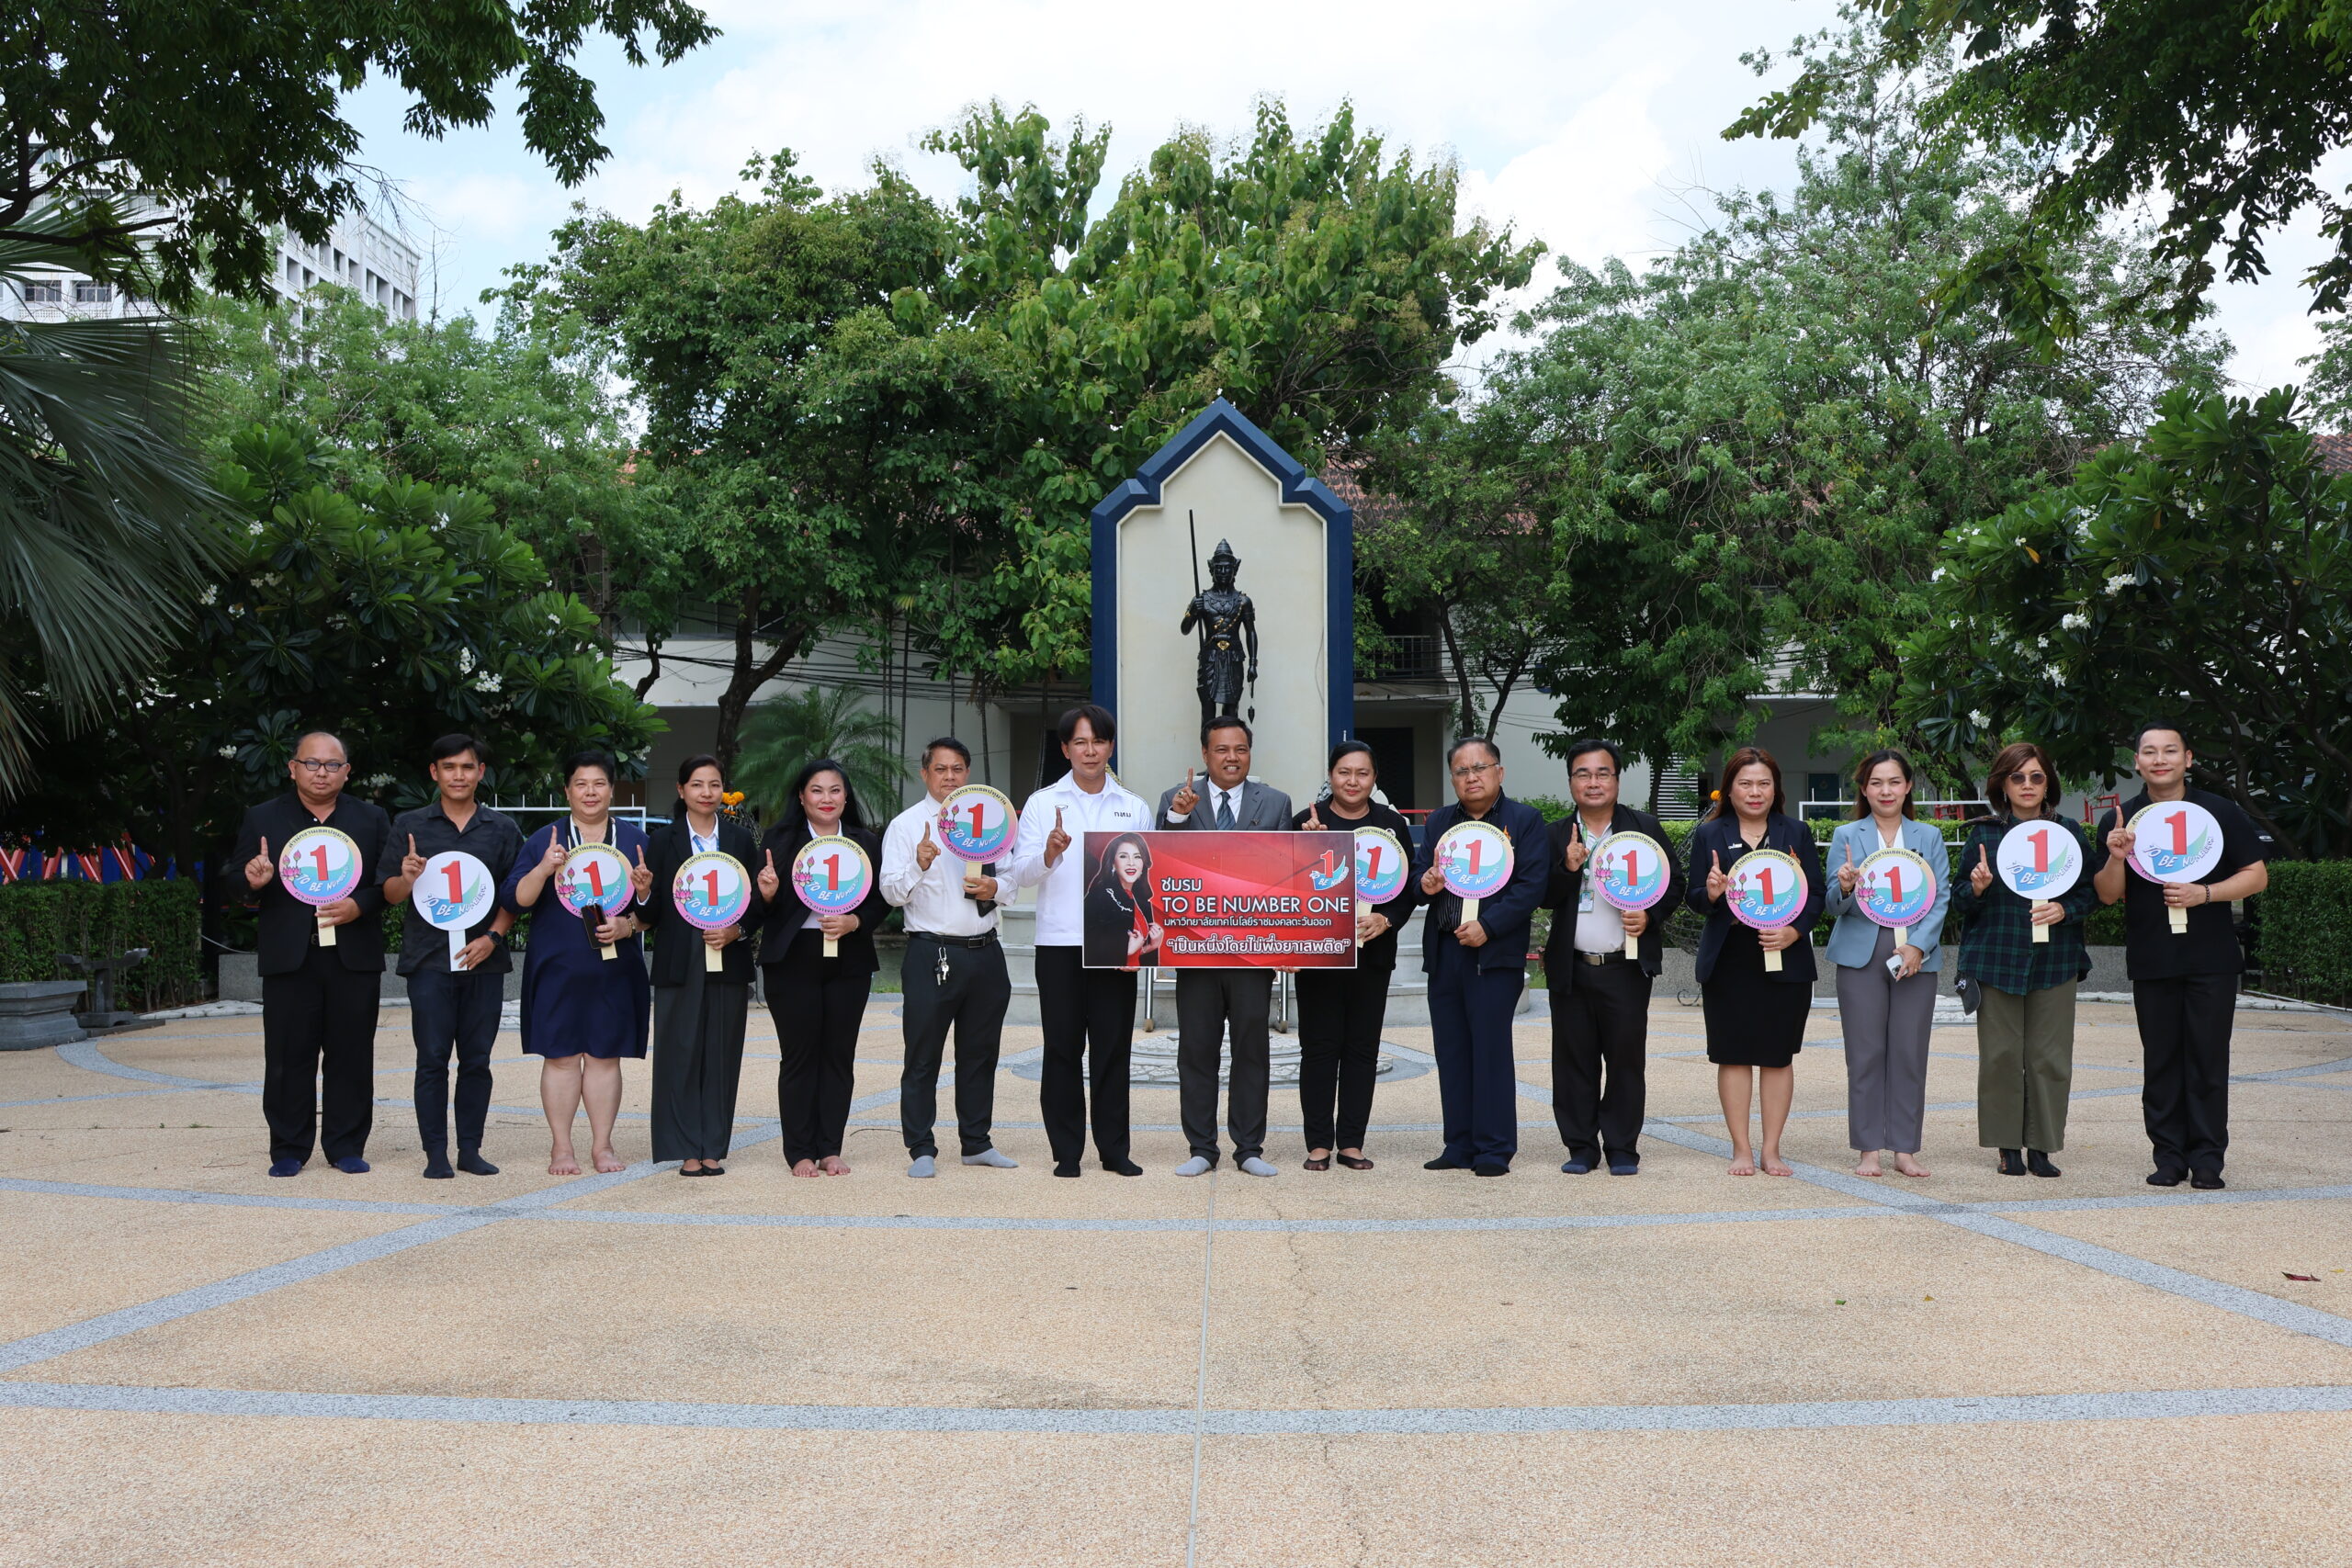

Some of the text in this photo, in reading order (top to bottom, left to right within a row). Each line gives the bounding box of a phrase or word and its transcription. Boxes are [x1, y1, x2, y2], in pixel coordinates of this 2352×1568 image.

[967, 803, 984, 838] 1
[2165, 811, 2188, 855] 1
[962, 838, 977, 847] BE
[1465, 840, 1482, 874] 1
[2027, 829, 2049, 873] 1
[310, 844, 329, 881] 1
[1367, 846, 1382, 881] 1
[1622, 850, 1637, 886] 1
[2157, 855, 2178, 867] BE
[583, 861, 604, 897] 1
[823, 854, 839, 890] 1
[1458, 874, 1473, 885] BE
[2020, 873, 2040, 885] BE
[309, 882, 323, 892] BE
[441, 860, 463, 904] 1
[702, 870, 718, 906] 1
[1161, 877, 1202, 892] ชมรม
[1357, 876, 1371, 887] BE
[1755, 867, 1774, 905] 1
[1884, 866, 1903, 903] 1
[818, 890, 832, 900] BE
[1619, 886, 1633, 897] BE
[435, 904, 455, 916] BE
[698, 907, 713, 916] BE
[1162, 897, 1350, 912] TO BE NUMBER ONE
[1754, 907, 1770, 916] BE
[1883, 904, 1898, 913] BE
[1164, 916, 1332, 927] มหาวิทยาลัยเทคโนโลยีราชมงคลตะวันออก
